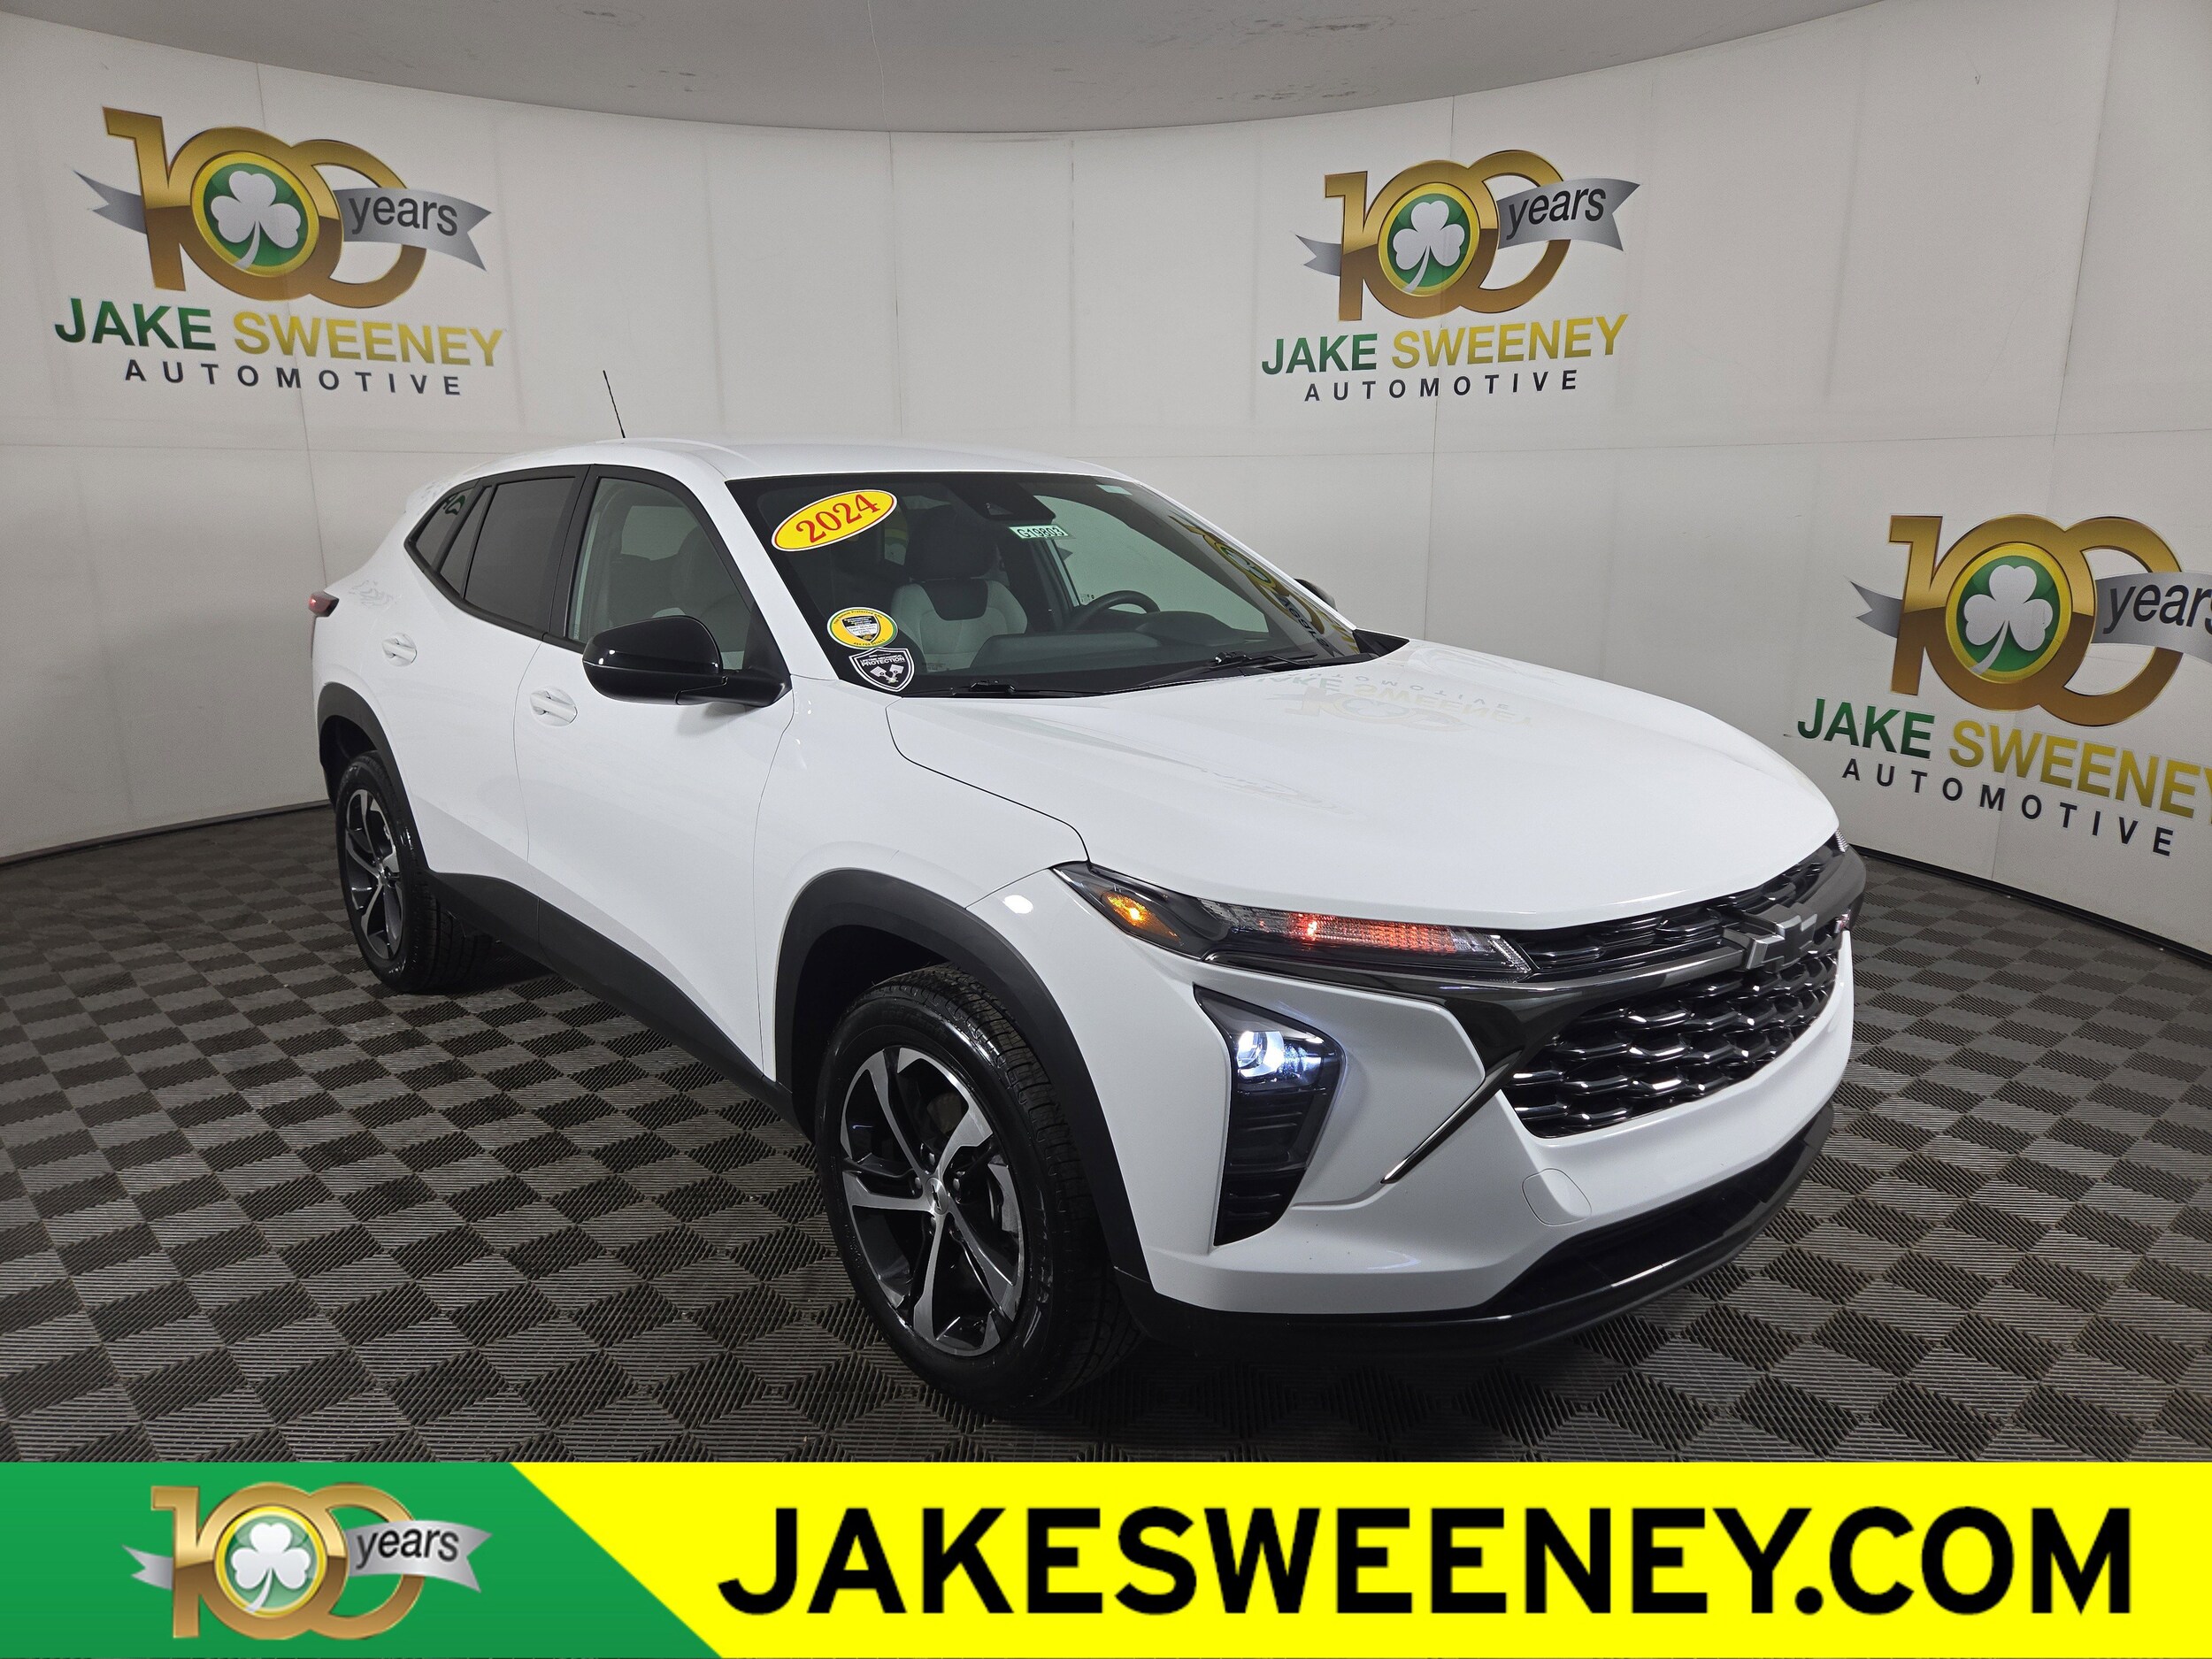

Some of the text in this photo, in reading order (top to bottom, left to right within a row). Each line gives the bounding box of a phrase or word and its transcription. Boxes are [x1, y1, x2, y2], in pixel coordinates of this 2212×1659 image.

[103, 106, 426, 309] 100
[349, 196, 459, 237] years
[1324, 149, 1571, 321] 100
[1506, 186, 1607, 241] years
[54, 296, 503, 367] JAKE SWEENEY
[1261, 312, 1629, 375] JAKE SWEENEY
[124, 358, 461, 396] AUTOMOTIVE
[1303, 369, 1578, 403] AUTOMOTIVE
[795, 493, 881, 544] 2024
[1016, 526, 1065, 538] G19803
[1888, 512, 2185, 727] 100
[2101, 581, 2212, 635] year
[861, 657, 906, 667] PROTECTION
[1796, 697, 1936, 759] JAKE
[1841, 757, 2174, 856] AUTOMOTIVE
